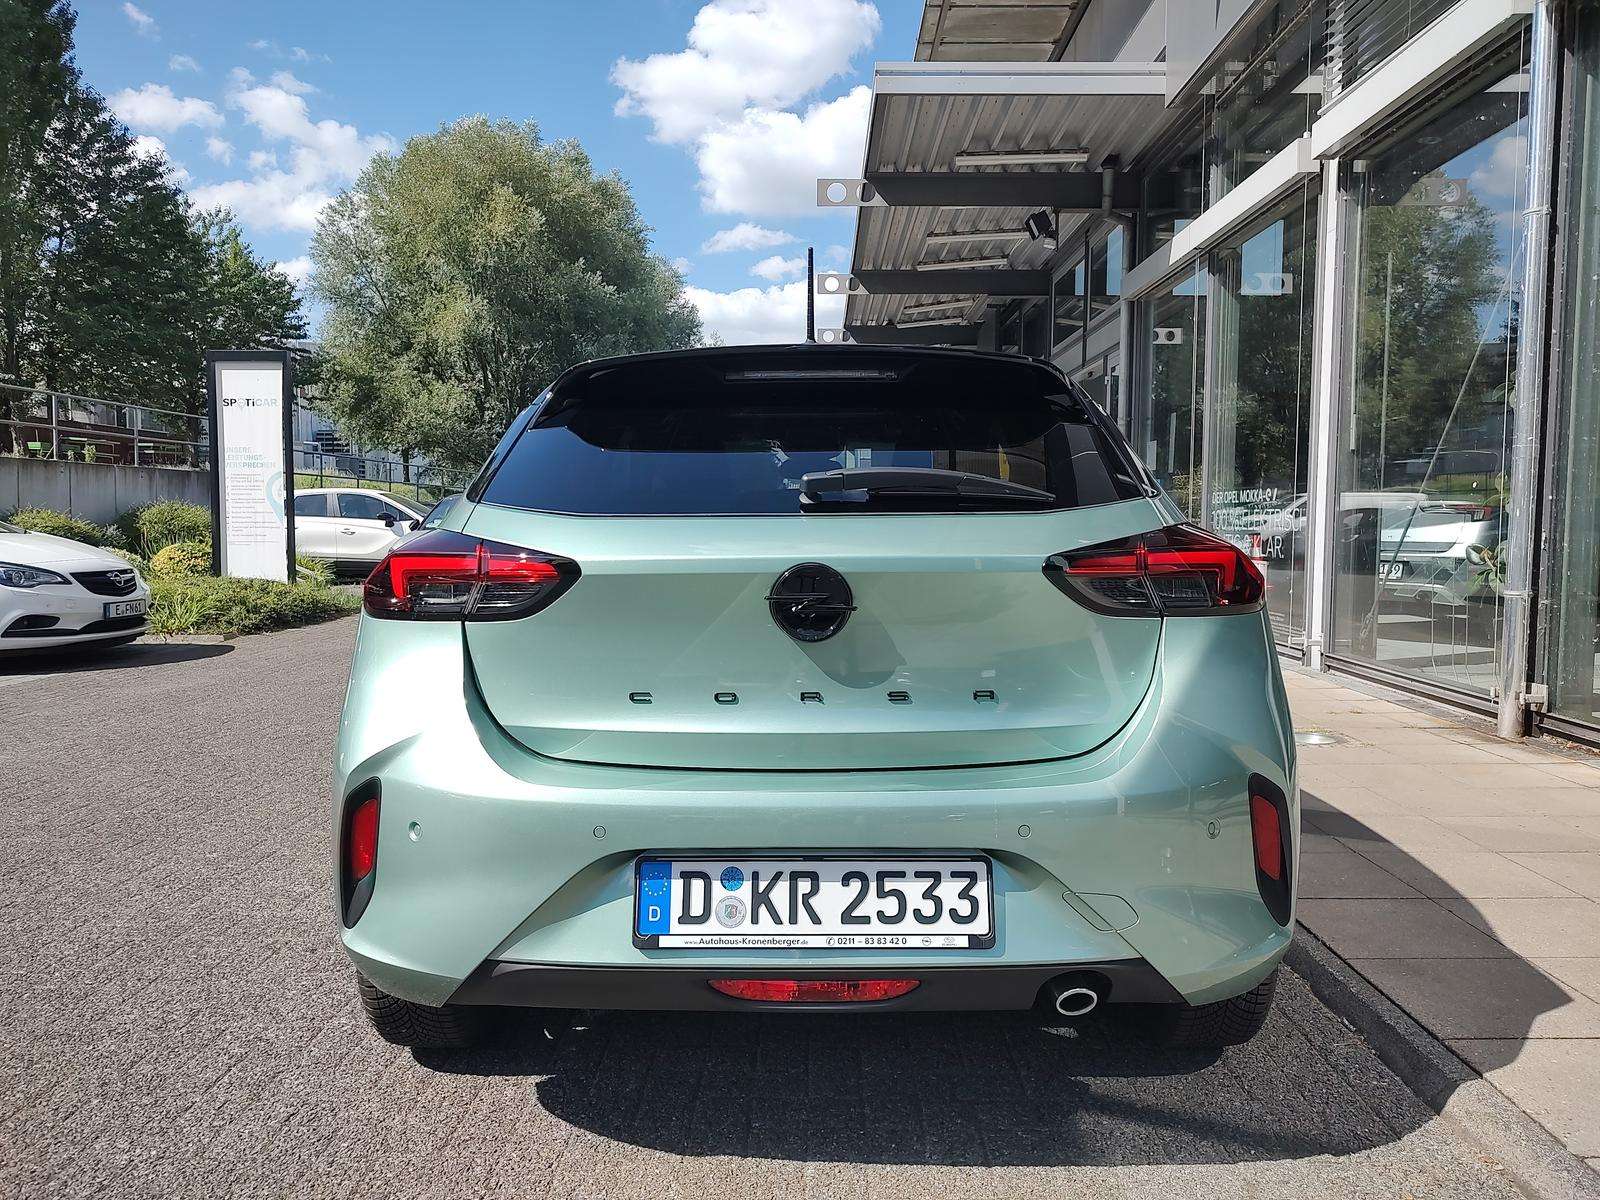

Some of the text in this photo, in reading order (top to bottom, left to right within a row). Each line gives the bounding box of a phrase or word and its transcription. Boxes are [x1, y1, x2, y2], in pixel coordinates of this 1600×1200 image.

[1224, 490, 1239, 503] OPEL
[116, 605, 120, 615] E
[628, 689, 997, 704] CORSA
[648, 905, 661, 922] D
[678, 870, 712, 925] D
[751, 870, 822, 925] KR
[841, 870, 979, 925] 2533
[837, 937, 855, 945] 0211
[864, 937, 875, 945] 83
[877, 937, 888, 945] 83
